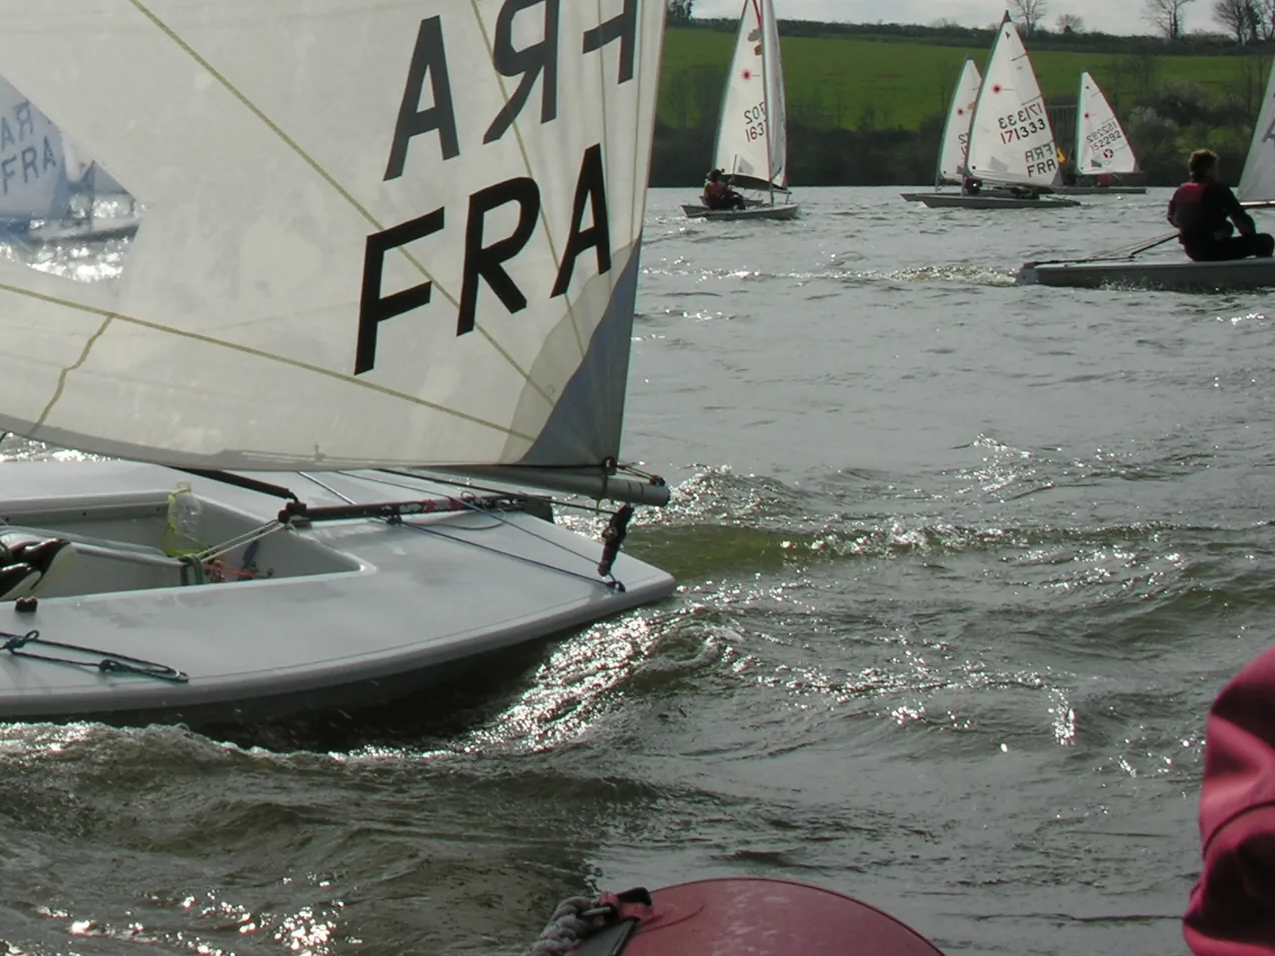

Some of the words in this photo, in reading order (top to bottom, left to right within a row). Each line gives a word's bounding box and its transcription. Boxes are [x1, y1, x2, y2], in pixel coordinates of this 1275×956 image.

[1000, 118, 1046, 145] 171333
[1, 135, 57, 196] FRA
[1027, 158, 1057, 178] FRA
[354, 142, 612, 376] FRA
